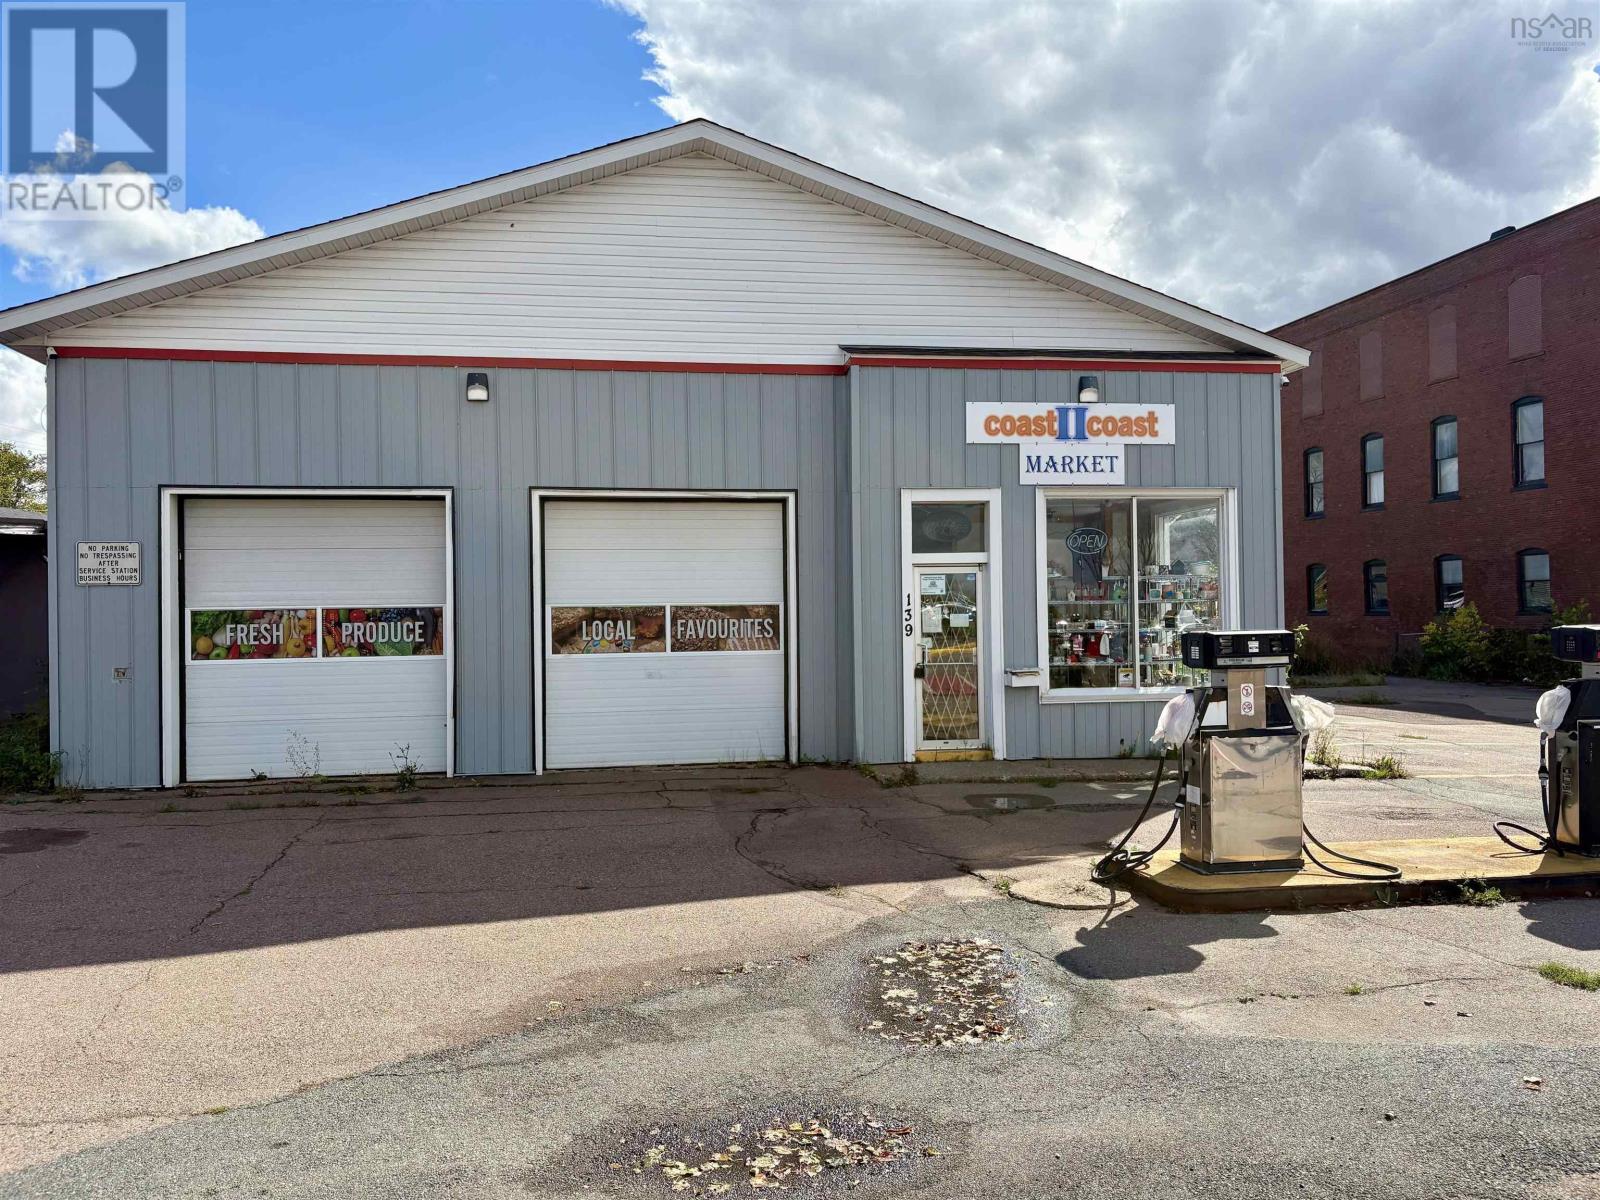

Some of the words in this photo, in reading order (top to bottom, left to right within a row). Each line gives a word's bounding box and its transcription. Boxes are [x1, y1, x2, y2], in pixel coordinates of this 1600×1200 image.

[984, 409, 1057, 437] coast
[1086, 411, 1159, 438] coast
[1025, 455, 1119, 474] MARKET
[1070, 534, 1105, 548] OPEN
[904, 592, 914, 637] 139
[225, 623, 284, 645] FRESH
[341, 621, 425, 644] PRODUCE
[581, 619, 636, 641] LOCAL
[677, 617, 774, 639] FAVOURITES
